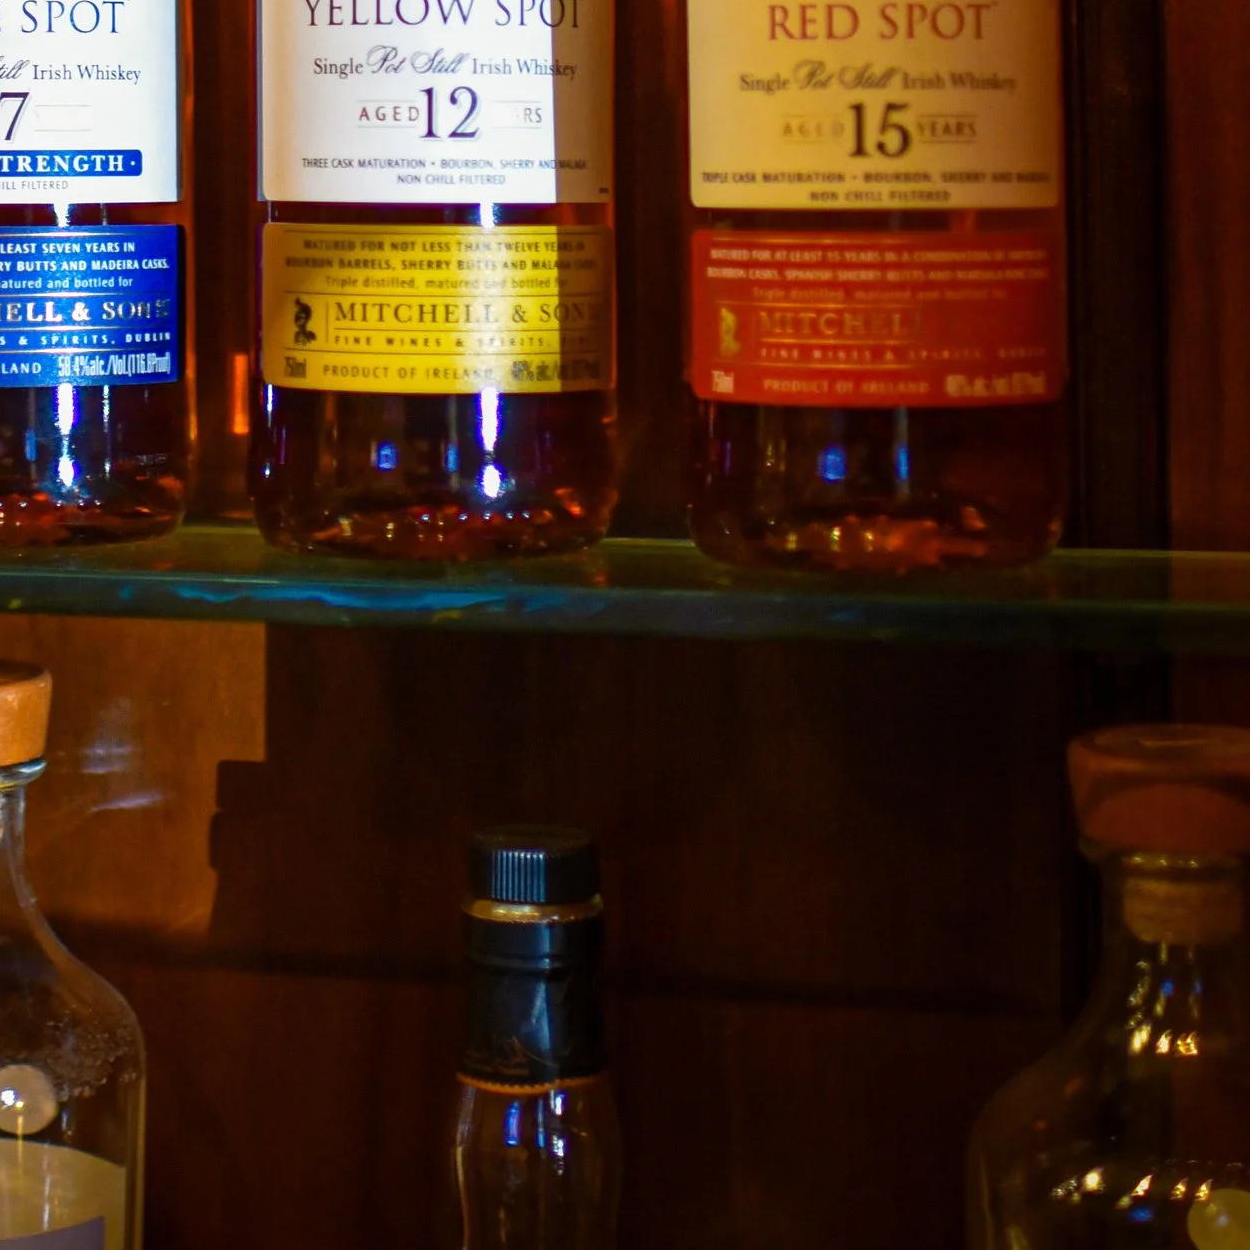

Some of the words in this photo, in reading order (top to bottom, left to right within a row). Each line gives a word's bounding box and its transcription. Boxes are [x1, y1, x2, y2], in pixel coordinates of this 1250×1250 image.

[20, 0, 126, 34] SPOT
[768, 3, 859, 41] RED
[879, 2, 991, 41] SPOT
[313, 58, 363, 79] Single
[366, 45, 406, 74] Pot
[409, 48, 470, 75] Still
[472, 58, 512, 75] Irish
[516, 58, 578, 80] Whiskey
[32, 64, 73, 81] Irish
[78, 64, 142, 86] Whiskey
[739, 74, 790, 96] Single
[793, 59, 833, 91] Pot
[837, 62, 900, 91] Still
[902, 73, 946, 91] Irish
[951, 73, 1016, 95] Whiskey
[358, 105, 419, 122] AGED
[419, 85, 480, 140] 12
[782, 121, 844, 137] AGED
[848, 101, 911, 158] 15
[916, 121, 977, 138] YEARS
[302, 158, 328, 168] THREE
[331, 158, 354, 168] CASK
[357, 158, 427, 168] MATURATION
[499, 159, 536, 170] SHERRY
[538, 159, 557, 170] AND
[397, 175, 421, 185] NON
[425, 175, 455, 185] CHILL
[459, 175, 506, 185] FILTERED
[762, 172, 845, 183] MATURATION
[21, 180, 69, 190] FILTERED
[0, 243, 36, 254] LEAST
[42, 243, 81, 254] SEVEN
[85, 242, 120, 253] YEARS
[124, 242, 135, 252] IN
[360, 240, 385, 251] FOR
[390, 241, 416, 252] NOT
[422, 241, 451, 252] LESS
[456, 241, 492, 252] THAN
[497, 241, 540, 252] TWELVE
[17, 261, 57, 271] BUTTS
[61, 260, 88, 271] AND
[91, 260, 140, 270] MADEIRA
[401, 259, 451, 270] SHERRY
[502, 260, 527, 271] AND
[47, 278, 70, 289] and
[74, 277, 114, 288] bottled
[118, 276, 133, 287] for
[71, 301, 91, 321] &
[334, 303, 499, 324] MITCHELL
[512, 304, 528, 323] &
[18, 336, 28, 346] &
[126, 332, 172, 343] DUBLIN
[334, 335, 373, 346] FINE
[385, 337, 442, 347] WINES
[323, 364, 389, 378] PRODUCT
[398, 366, 417, 379] OF
